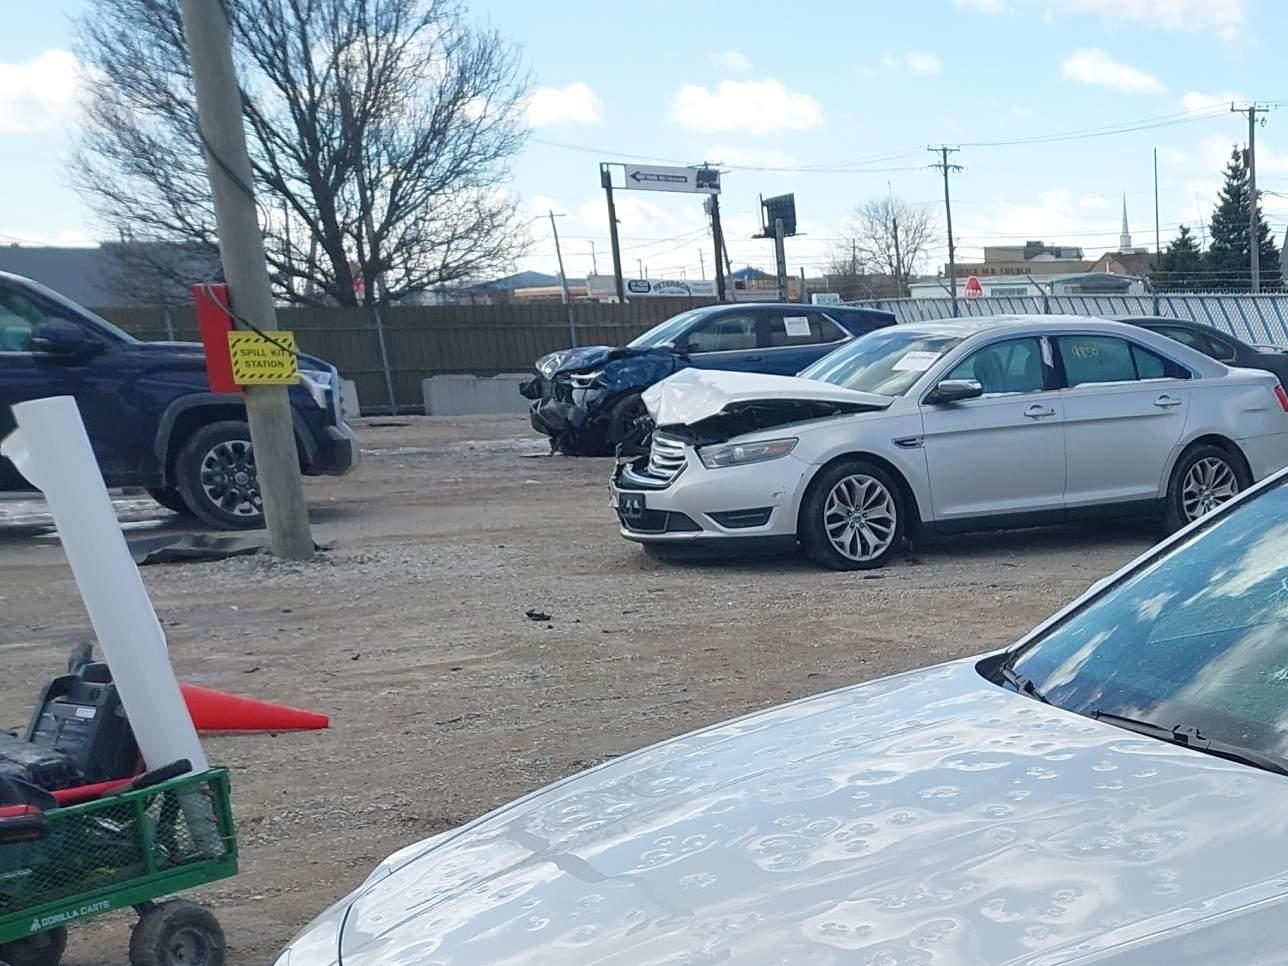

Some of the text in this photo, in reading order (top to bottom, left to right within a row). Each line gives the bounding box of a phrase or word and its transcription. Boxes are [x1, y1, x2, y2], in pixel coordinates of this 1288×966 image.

[1000, 267, 1032, 275] CHURCH
[240, 348, 285, 357] SPILL KIT
[245, 360, 285, 368] STATION
[41, 900, 110, 927] GORILLA CARTS
